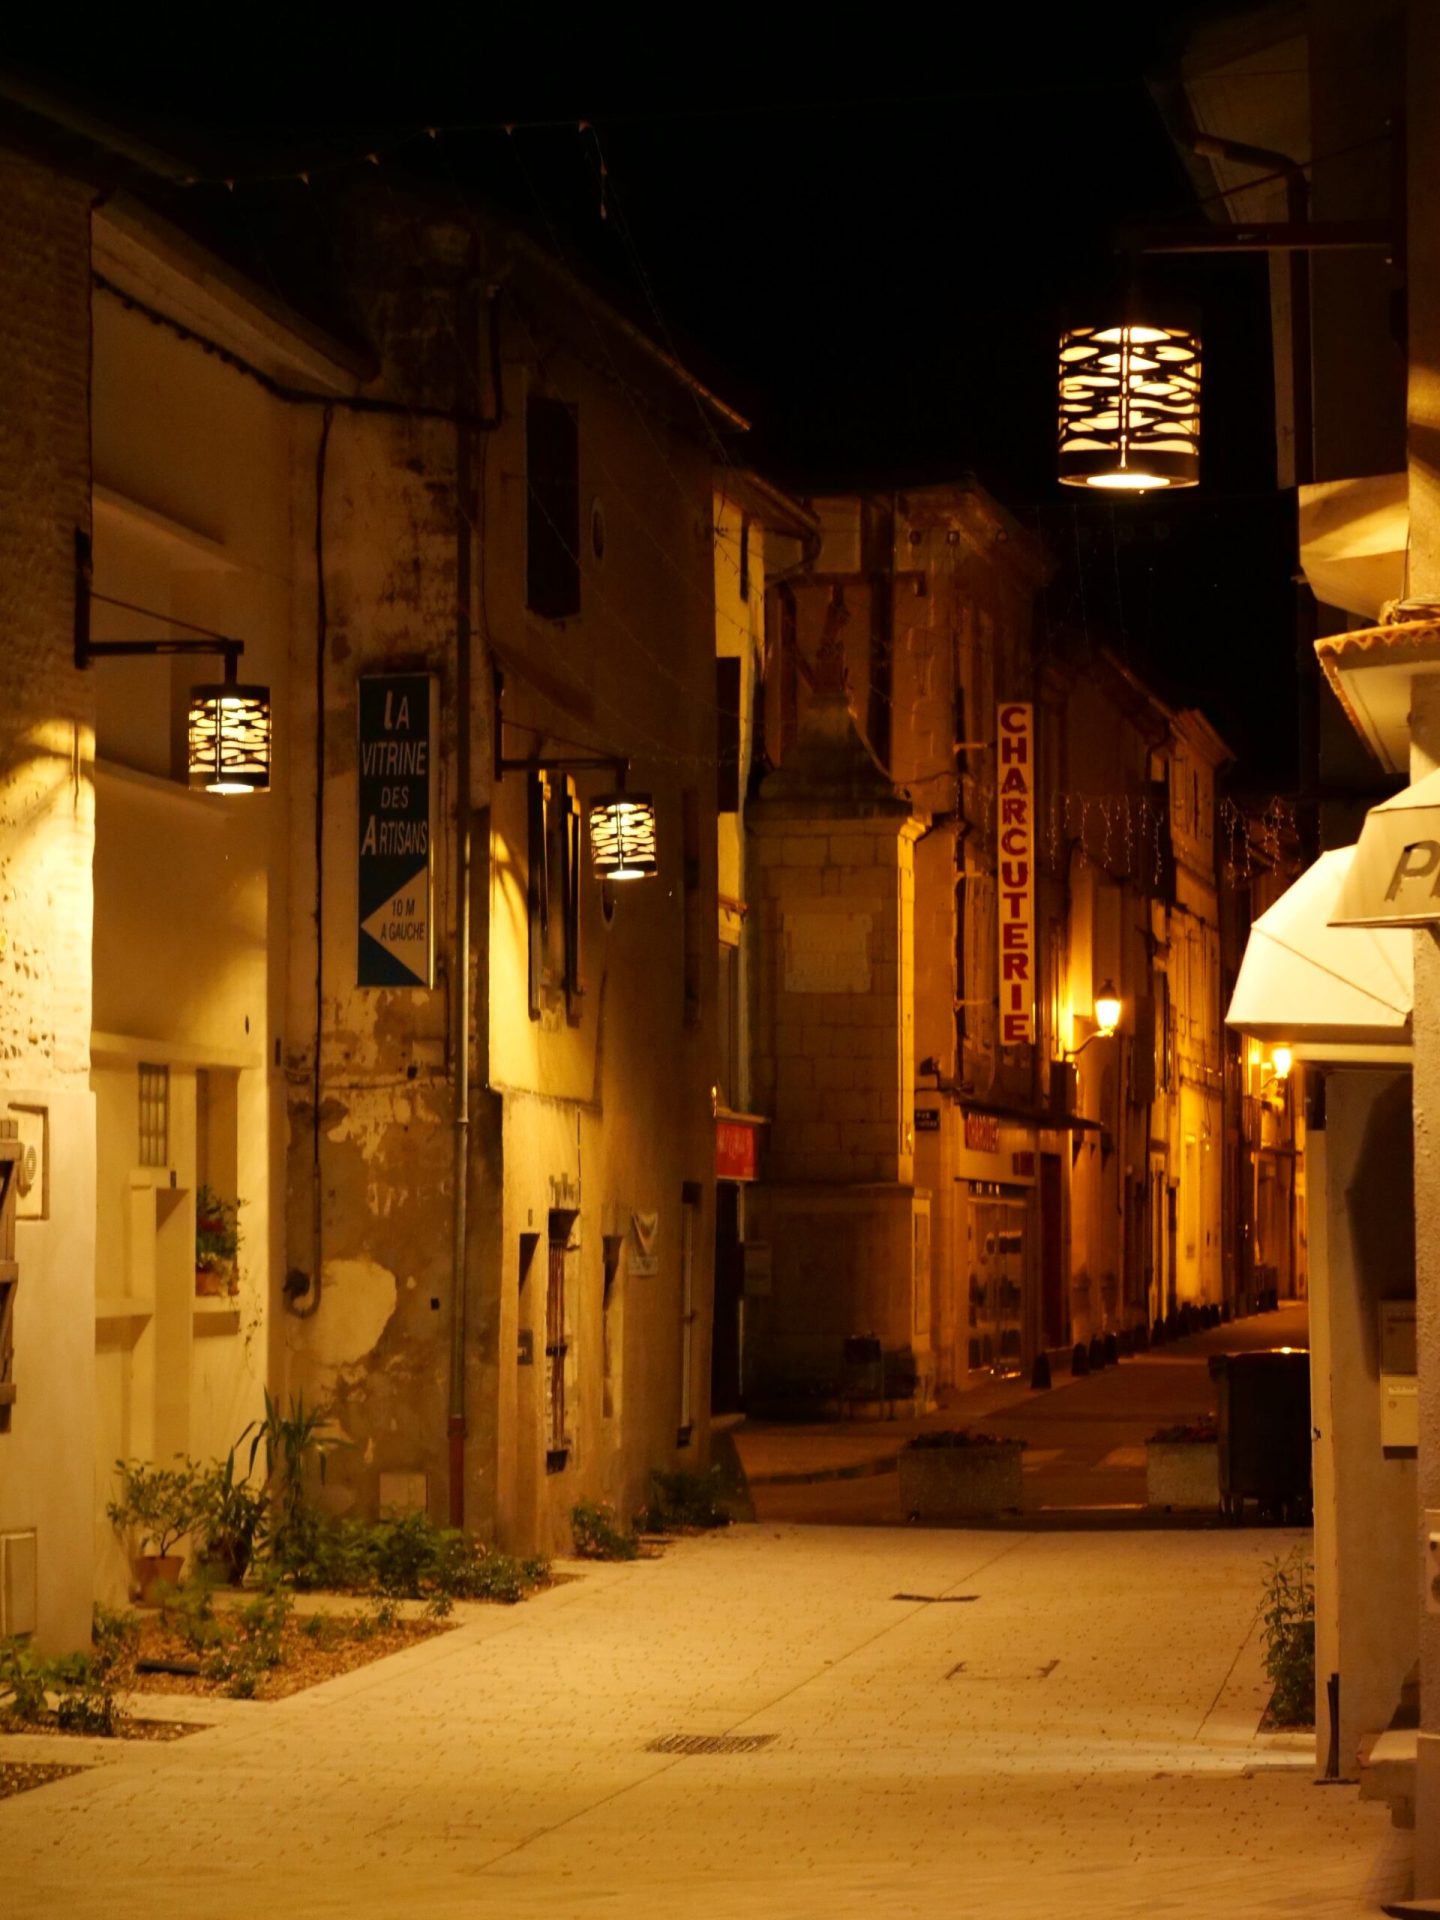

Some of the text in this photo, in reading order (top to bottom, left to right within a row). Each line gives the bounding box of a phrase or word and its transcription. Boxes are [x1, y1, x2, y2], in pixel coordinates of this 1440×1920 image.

[384, 689, 410, 731] LA
[362, 741, 427, 777] VITRINE
[380, 786, 410, 809] DES
[1001, 706, 1029, 1042] CHARCUTERIE
[389, 922, 425, 941] GAUCHE
